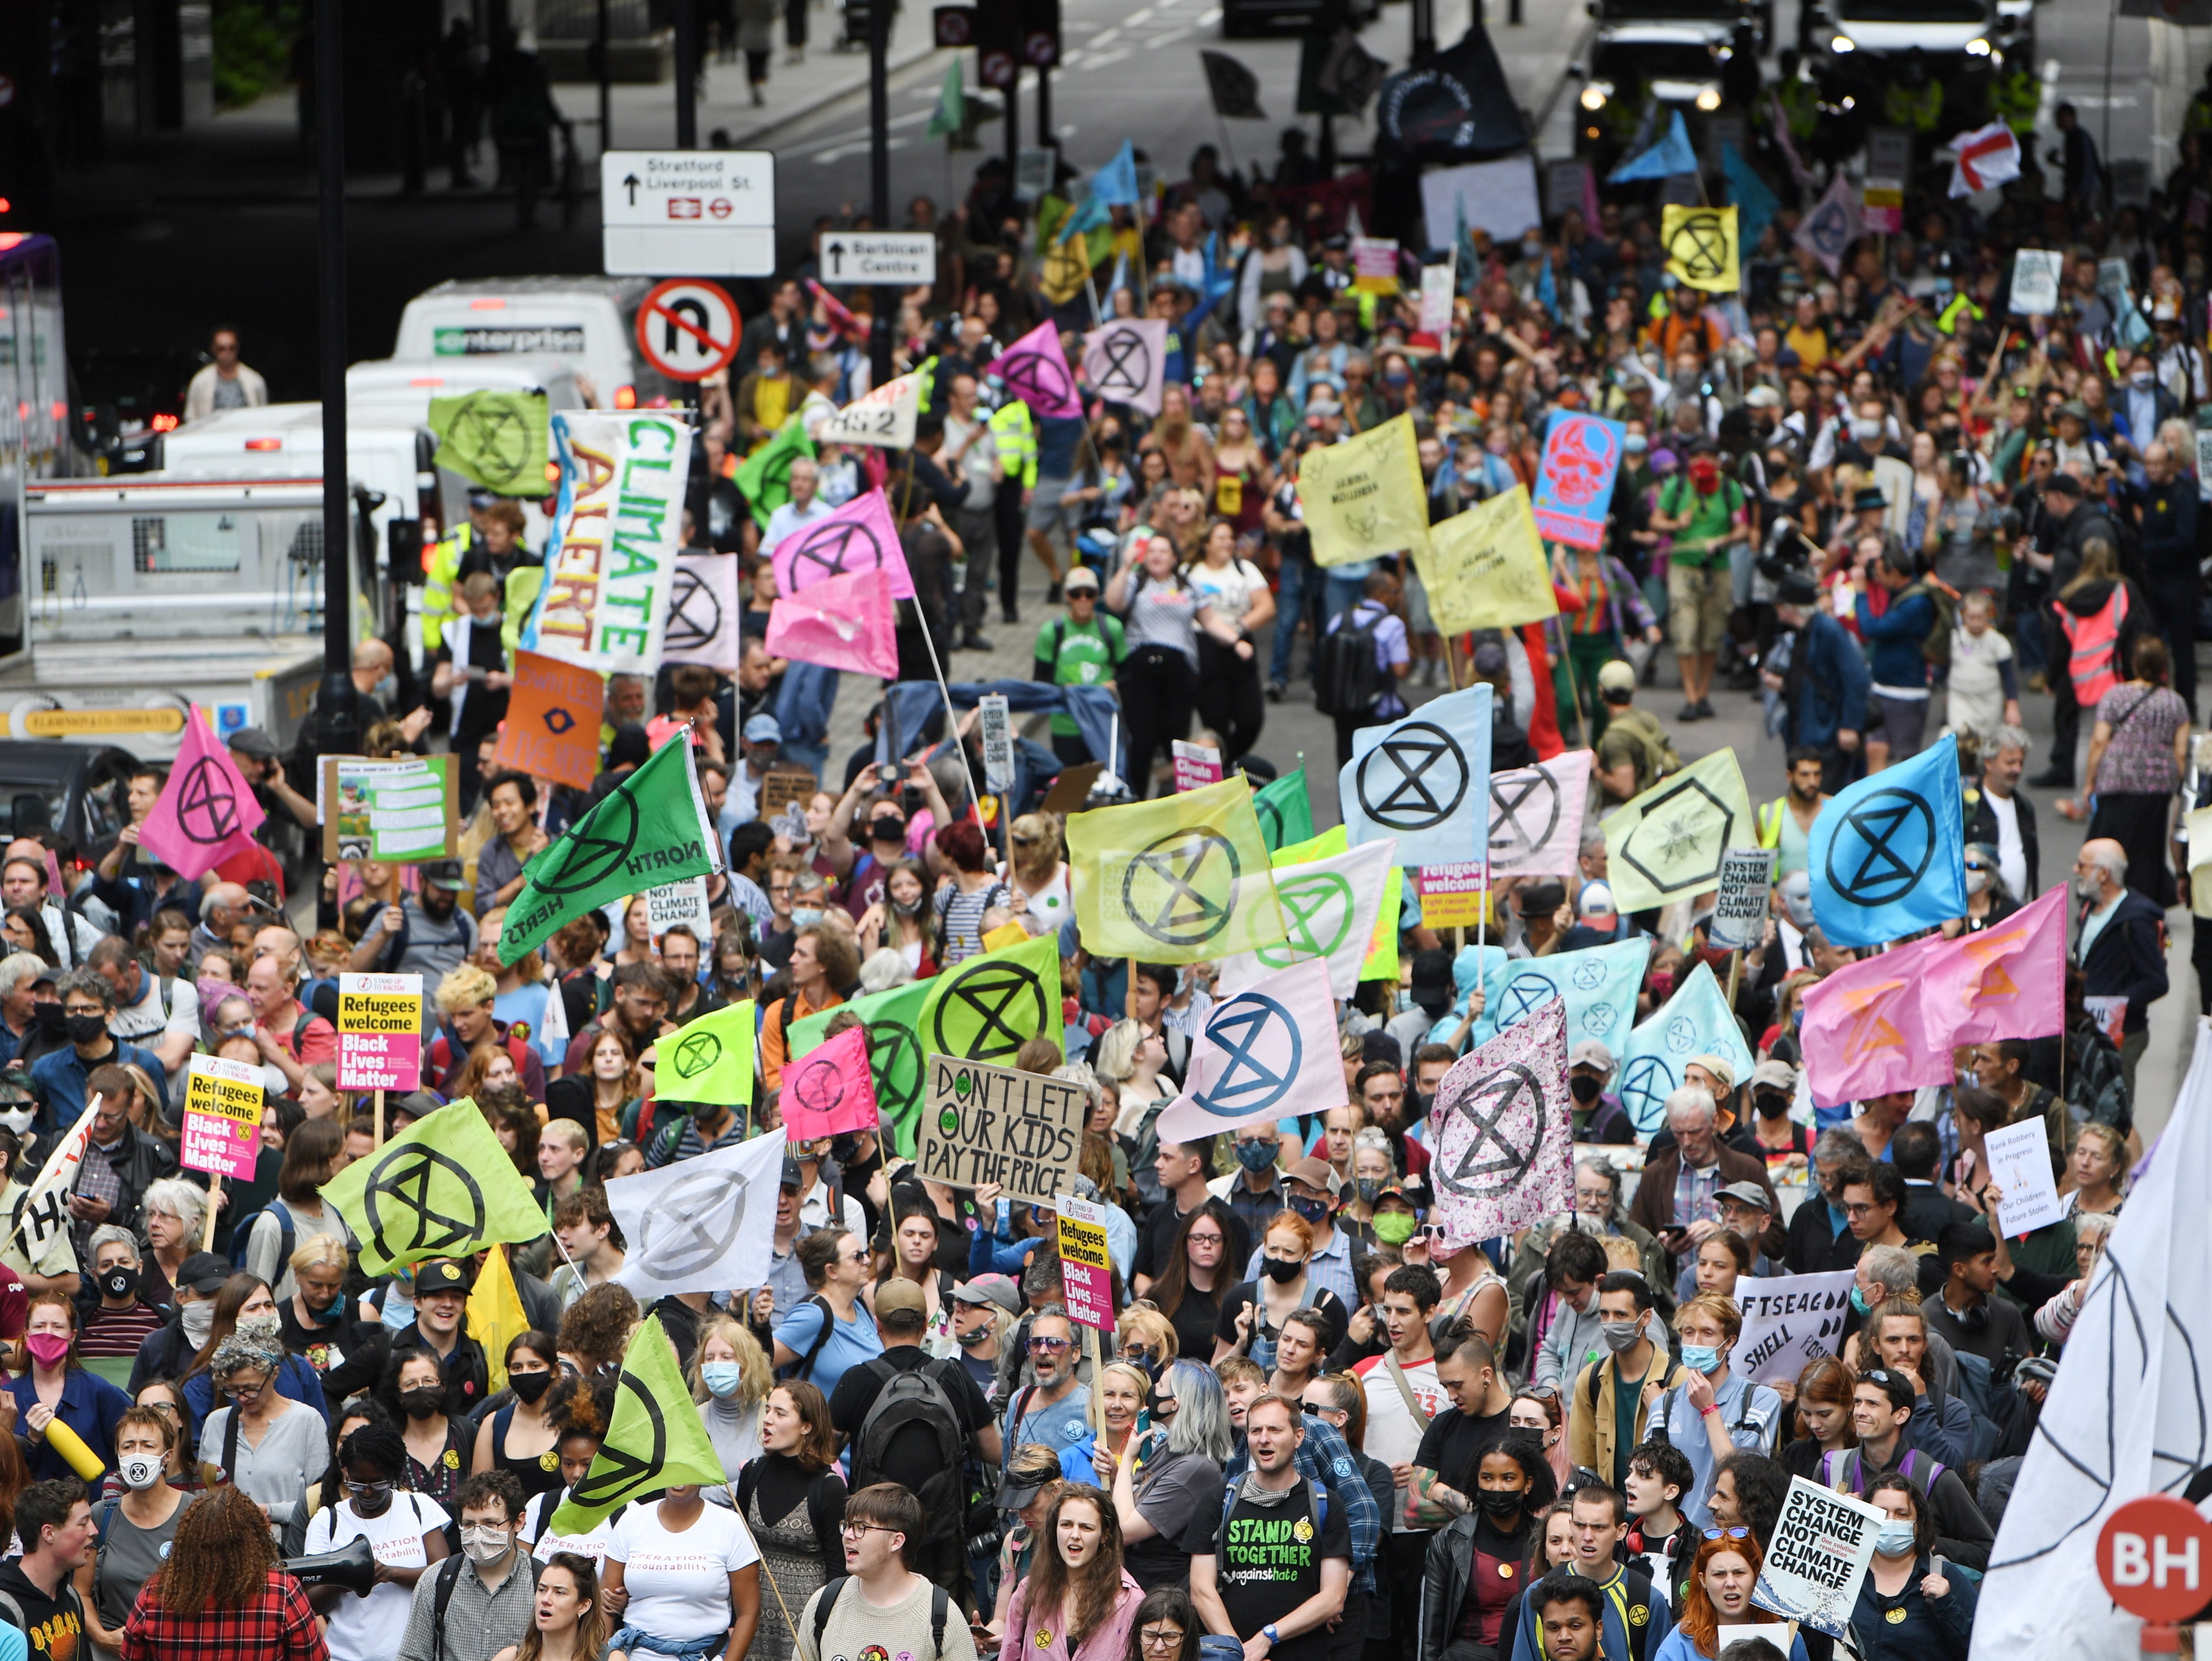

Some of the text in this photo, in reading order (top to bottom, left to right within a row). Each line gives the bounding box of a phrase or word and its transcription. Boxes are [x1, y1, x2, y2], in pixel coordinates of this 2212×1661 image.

[648, 158, 724, 172] Stratford
[648, 176, 723, 190] Liverpool
[853, 240, 928, 253] Barbican
[861, 258, 918, 272] Centre
[435, 328, 584, 353] enterprise
[541, 439, 616, 652] ALERT
[601, 419, 676, 655] CLIMATE
[515, 664, 602, 713] OWN LESS
[497, 726, 553, 775] LIVE
[1725, 861, 1768, 872] SYSTEM
[1723, 873, 1767, 884] CHANGE
[650, 889, 673, 898] NOT
[1721, 884, 1746, 895] NOT
[651, 896, 700, 909] CLIMATE
[1719, 895, 1765, 907] CLIMATE
[652, 908, 700, 922] CHANGE
[1717, 907, 1762, 918] CHANGE
[344, 997, 416, 1016] Refugees
[343, 1015, 413, 1030] welcome
[342, 1034, 388, 1052] Black
[223, 1063, 241, 1072] STAND
[341, 1052, 385, 1070] Lives
[230, 1070, 251, 1081] RACISM
[341, 1069, 398, 1087] Matter
[192, 1076, 259, 1104] Refugees
[936, 1062, 1077, 1124] DON'T LET
[191, 1097, 254, 1120] welcome
[187, 1112, 232, 1138] Black
[938, 1102, 1076, 1162] OUR KIDS
[185, 1130, 227, 1154] Lives
[1990, 1131, 2036, 1152] Bank Robbery
[184, 1148, 237, 1174] Matter
[1998, 1147, 2033, 1164] in Progress
[923, 1138, 1066, 1200] PAY THE PRICE
[1074, 1203, 1086, 1213] STAND
[2003, 1190, 2047, 1211] Our Childrens
[1075, 1210, 1095, 1222] TO RACISM
[2006, 1204, 2050, 1225] Future Stolen
[1060, 1219, 1104, 1247] Refugees
[1061, 1242, 1104, 1265] welcome
[1063, 1261, 1092, 1286] Black
[1065, 1280, 1091, 1304] Lives
[1067, 1299, 1101, 1325] Matter
[1744, 1323, 1794, 1375] SHELL
[1790, 1490, 1865, 1529] SYSTEM
[1228, 1519, 1292, 1543] STAND
[1780, 1520, 1820, 1546] NOT
[1786, 1506, 1864, 1546] CHANGE
[372, 1535, 418, 1551] RATION
[544, 1537, 605, 1550] OPERATIO
[1819, 1544, 1848, 1558] revolution
[1821, 1537, 1858, 1555] One solution:
[1227, 1544, 1311, 1567] TOGETHER
[1775, 1537, 1855, 1579] CLIMATE
[2113, 1532, 2199, 1591] BH
[627, 1562, 707, 1572] Accountability
[1232, 1566, 1298, 1586] #againsthate
[1770, 1552, 1848, 1591] CHANGE
[1787, 1597, 1808, 1610] swp.org.uk
[864, 1645, 878, 1654] BUILT
